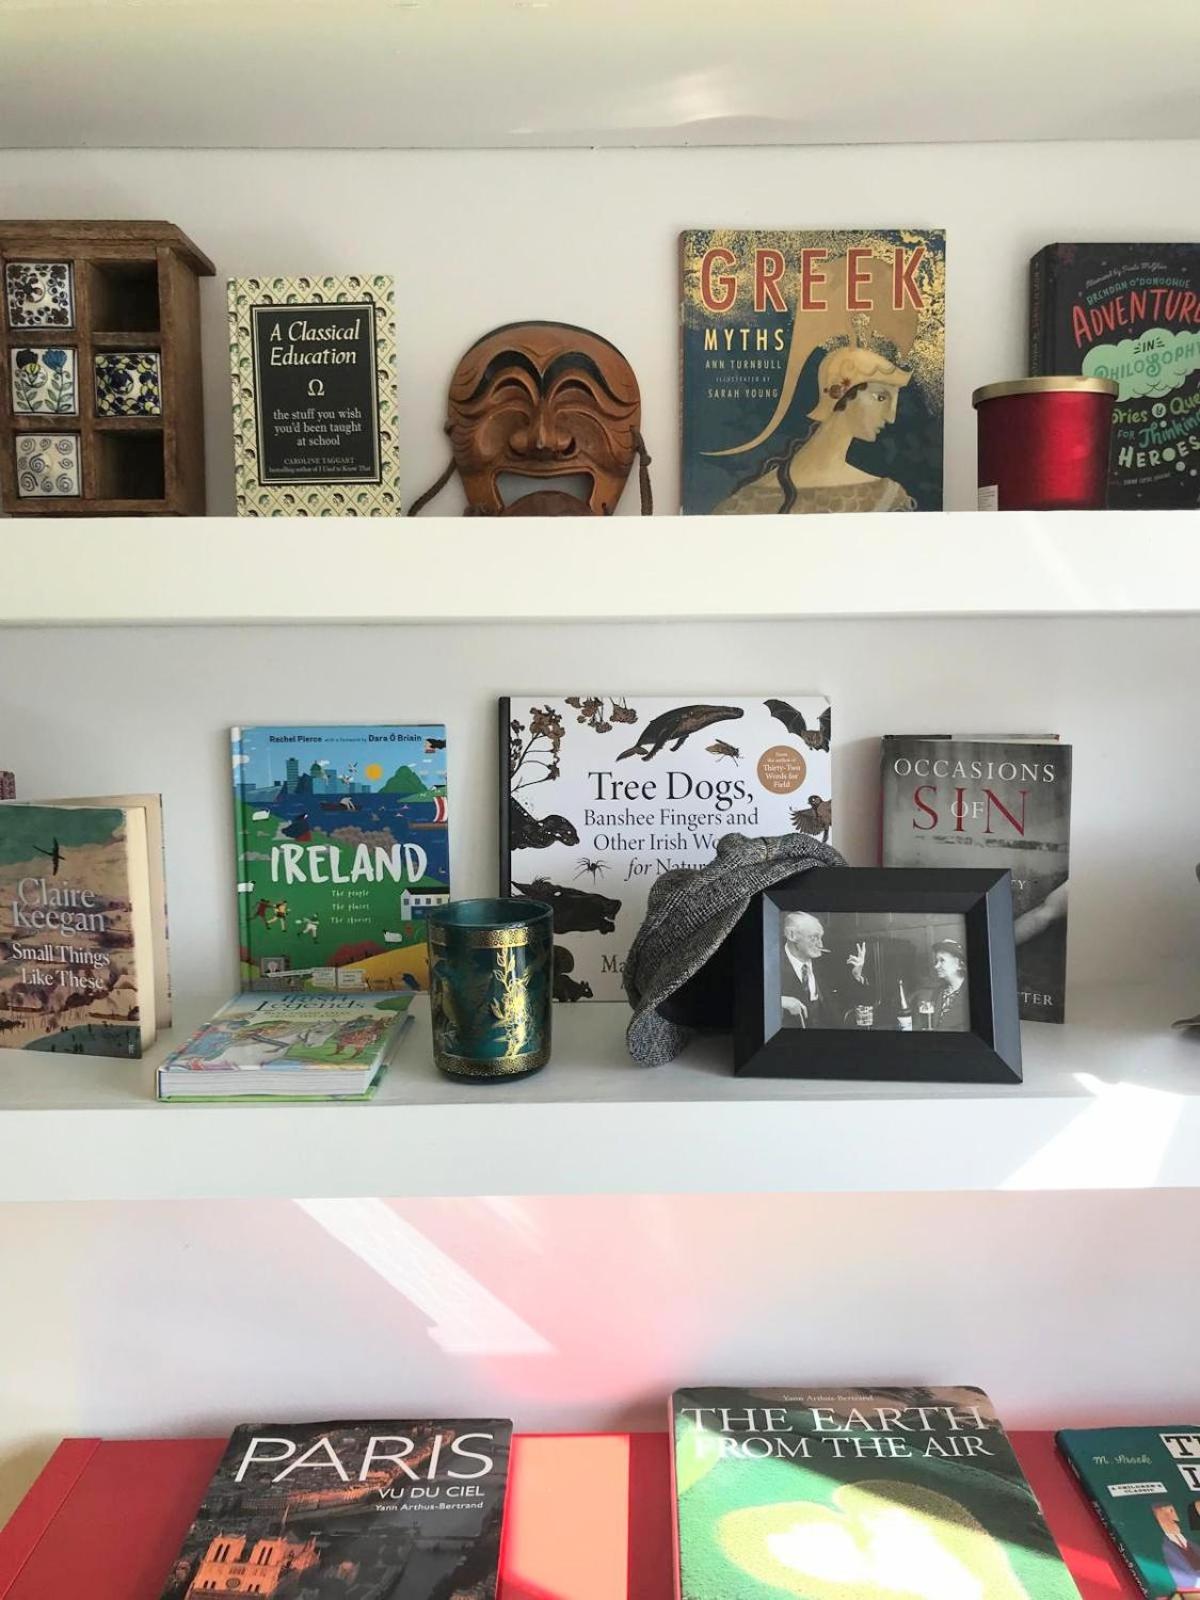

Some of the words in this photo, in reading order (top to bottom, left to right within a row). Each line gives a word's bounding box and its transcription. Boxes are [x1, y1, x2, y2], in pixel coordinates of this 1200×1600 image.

[699, 246, 927, 313] GREEK
[270, 323, 282, 342] A
[288, 319, 360, 341] Classical
[704, 328, 785, 351] MYTHS
[1142, 337, 1154, 351] IN
[270, 345, 356, 366] Education
[705, 360, 725, 369] ANN
[730, 360, 782, 369] TURNBULL
[708, 388, 739, 398] SARAH
[745, 388, 778, 398] YOUNG
[273, 409, 290, 420] the
[291, 408, 315, 420] stuff
[317, 411, 335, 423] you
[338, 407, 362, 419] wish
[274, 422, 301, 436] you'd
[303, 422, 327, 432] been
[330, 421, 362, 435] taught
[1117, 429, 1135, 440] FOR
[296, 437, 306, 446] at
[308, 435, 340, 446] school
[1118, 435, 1200, 468] HEROES
[269, 735, 296, 743] Rachel
[297, 735, 322, 743] Pierce
[368, 734, 388, 742] Dara
[397, 733, 422, 742] Briain
[894, 757, 1056, 783] OCCASIONS
[588, 771, 657, 801] Tree
[666, 771, 754, 810] Dogs,
[584, 808, 655, 826] Banshee
[660, 808, 722, 832] Fingers
[726, 808, 758, 826] and
[912, 784, 1030, 837] SIN
[950, 799, 985, 819] OF
[594, 832, 646, 851] Other
[649, 832, 687, 851] Irish
[271, 843, 428, 885] IRELAND
[624, 857, 653, 882] for
[17, 878, 96, 908] Claire
[332, 890, 344, 898] The
[12, 901, 106, 938] Keegan
[12, 943, 53, 962] Small
[56, 945, 111, 970] Things
[22, 968, 53, 987] Like
[56, 969, 104, 990] These
[254, 1000, 365, 1011] Legends
[681, 1407, 793, 1433] THE
[808, 1406, 990, 1432] EARTH
[234, 1433, 494, 1483] PARIS
[693, 1436, 813, 1461] FROM
[821, 1436, 912, 1458] THE
[922, 1436, 995, 1457] AIR
[379, 1487, 404, 1499] VU
[410, 1486, 440, 1498] DU
[446, 1485, 485, 1497] CIEL
[400, 1501, 484, 1511] Arthus-Bertrand
